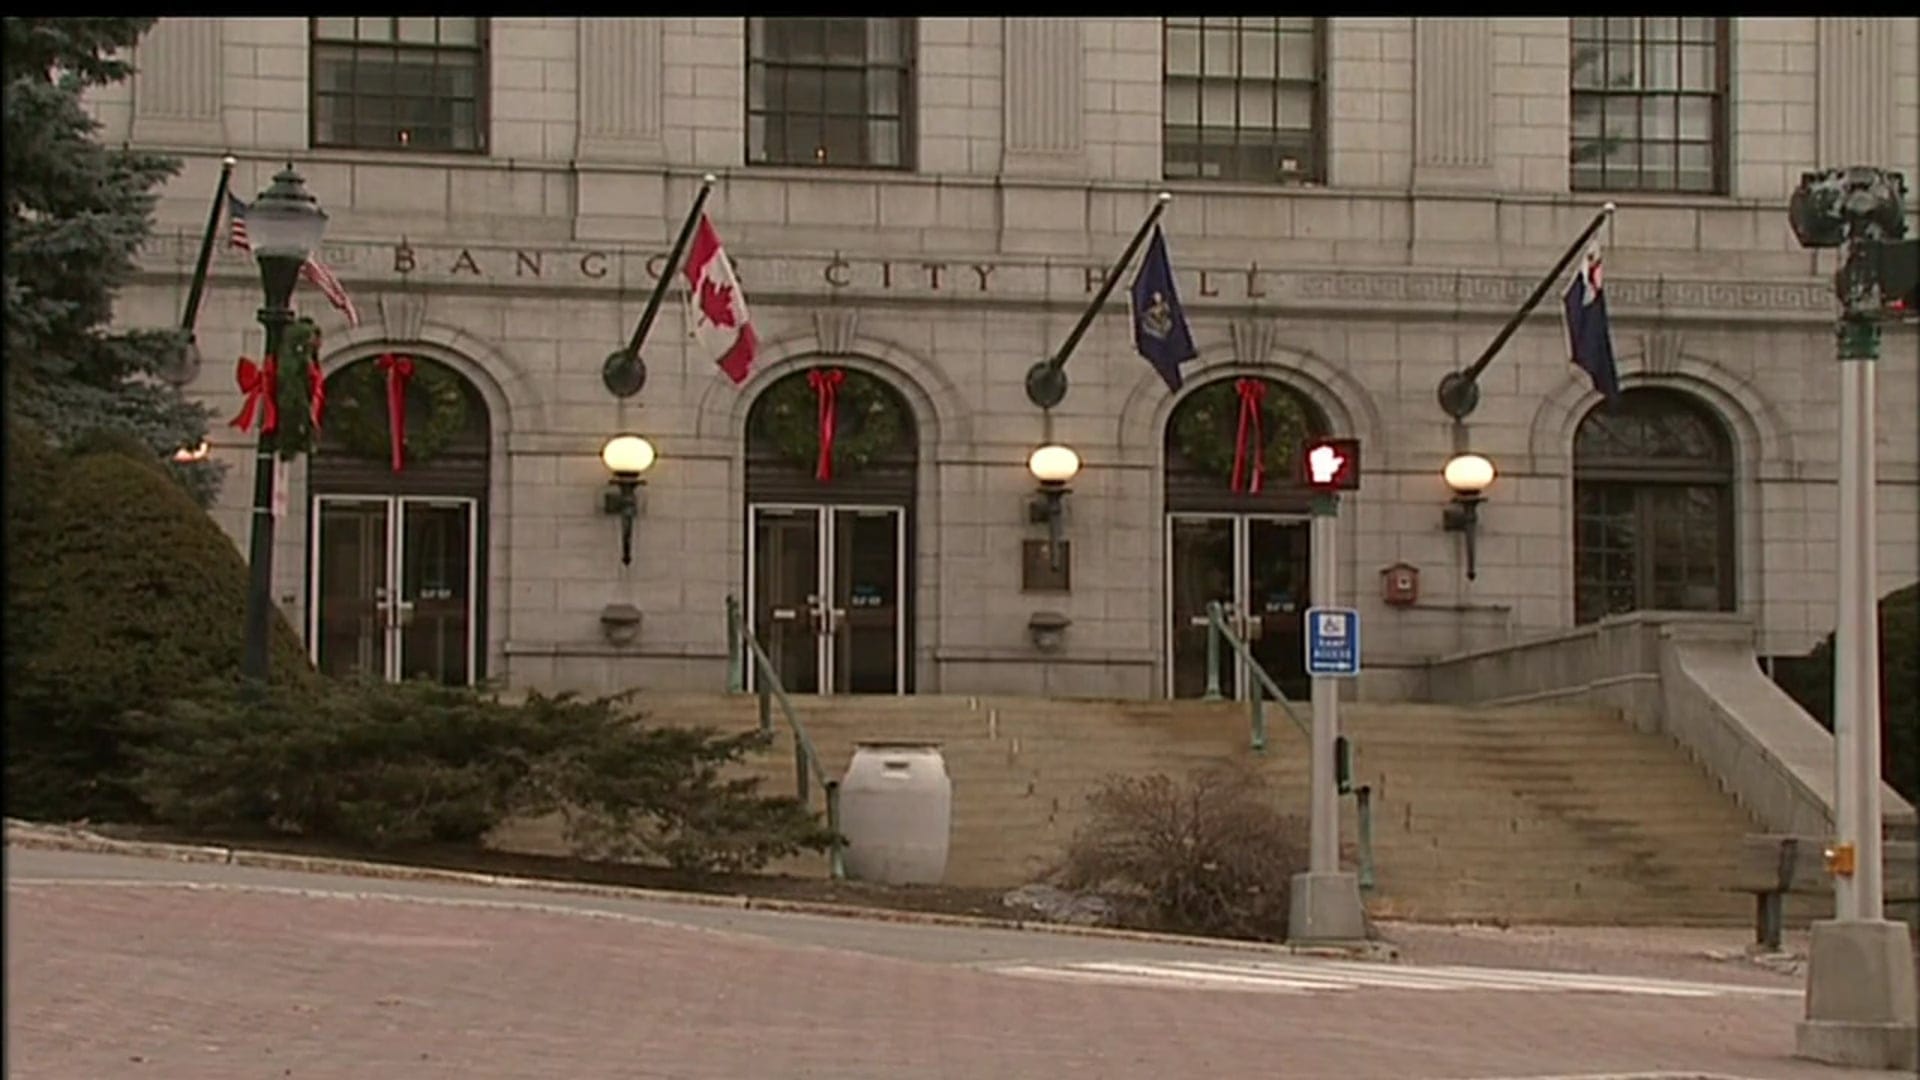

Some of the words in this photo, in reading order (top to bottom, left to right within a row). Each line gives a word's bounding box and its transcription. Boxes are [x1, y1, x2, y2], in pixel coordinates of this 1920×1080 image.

[394, 247, 742, 283] BANGO
[824, 261, 996, 291] CITY
[1085, 268, 1266, 298] HLL
